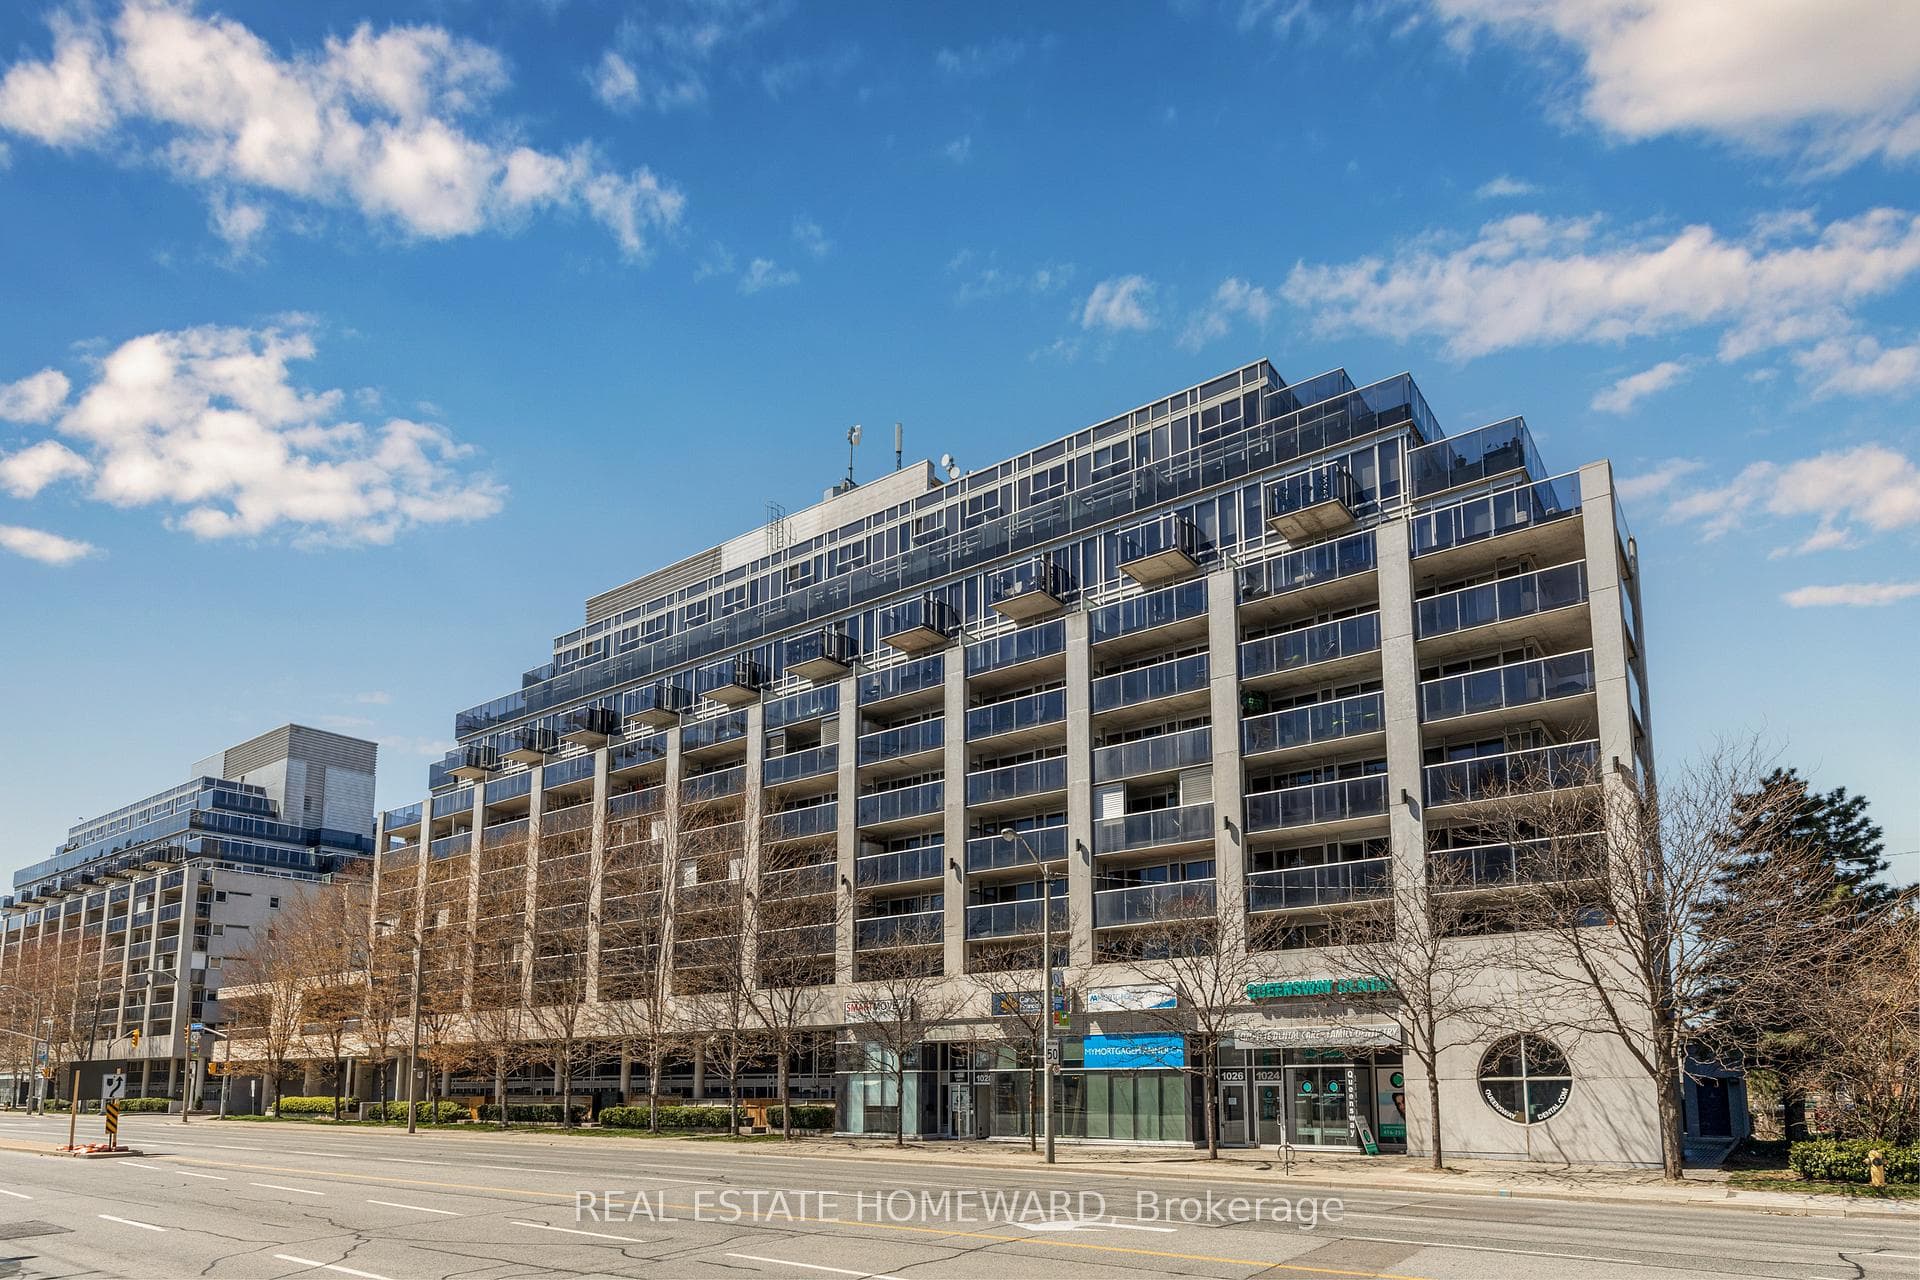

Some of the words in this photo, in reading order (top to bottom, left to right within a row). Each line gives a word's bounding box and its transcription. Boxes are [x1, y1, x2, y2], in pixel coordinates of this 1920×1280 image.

[1047, 1048, 1058, 1060] 50
[1221, 1071, 1244, 1080] 1026
[1256, 1071, 1280, 1080] 1024
[1347, 1070, 1356, 1138] Queensway
[1484, 1089, 1517, 1120] QUEENSWAY
